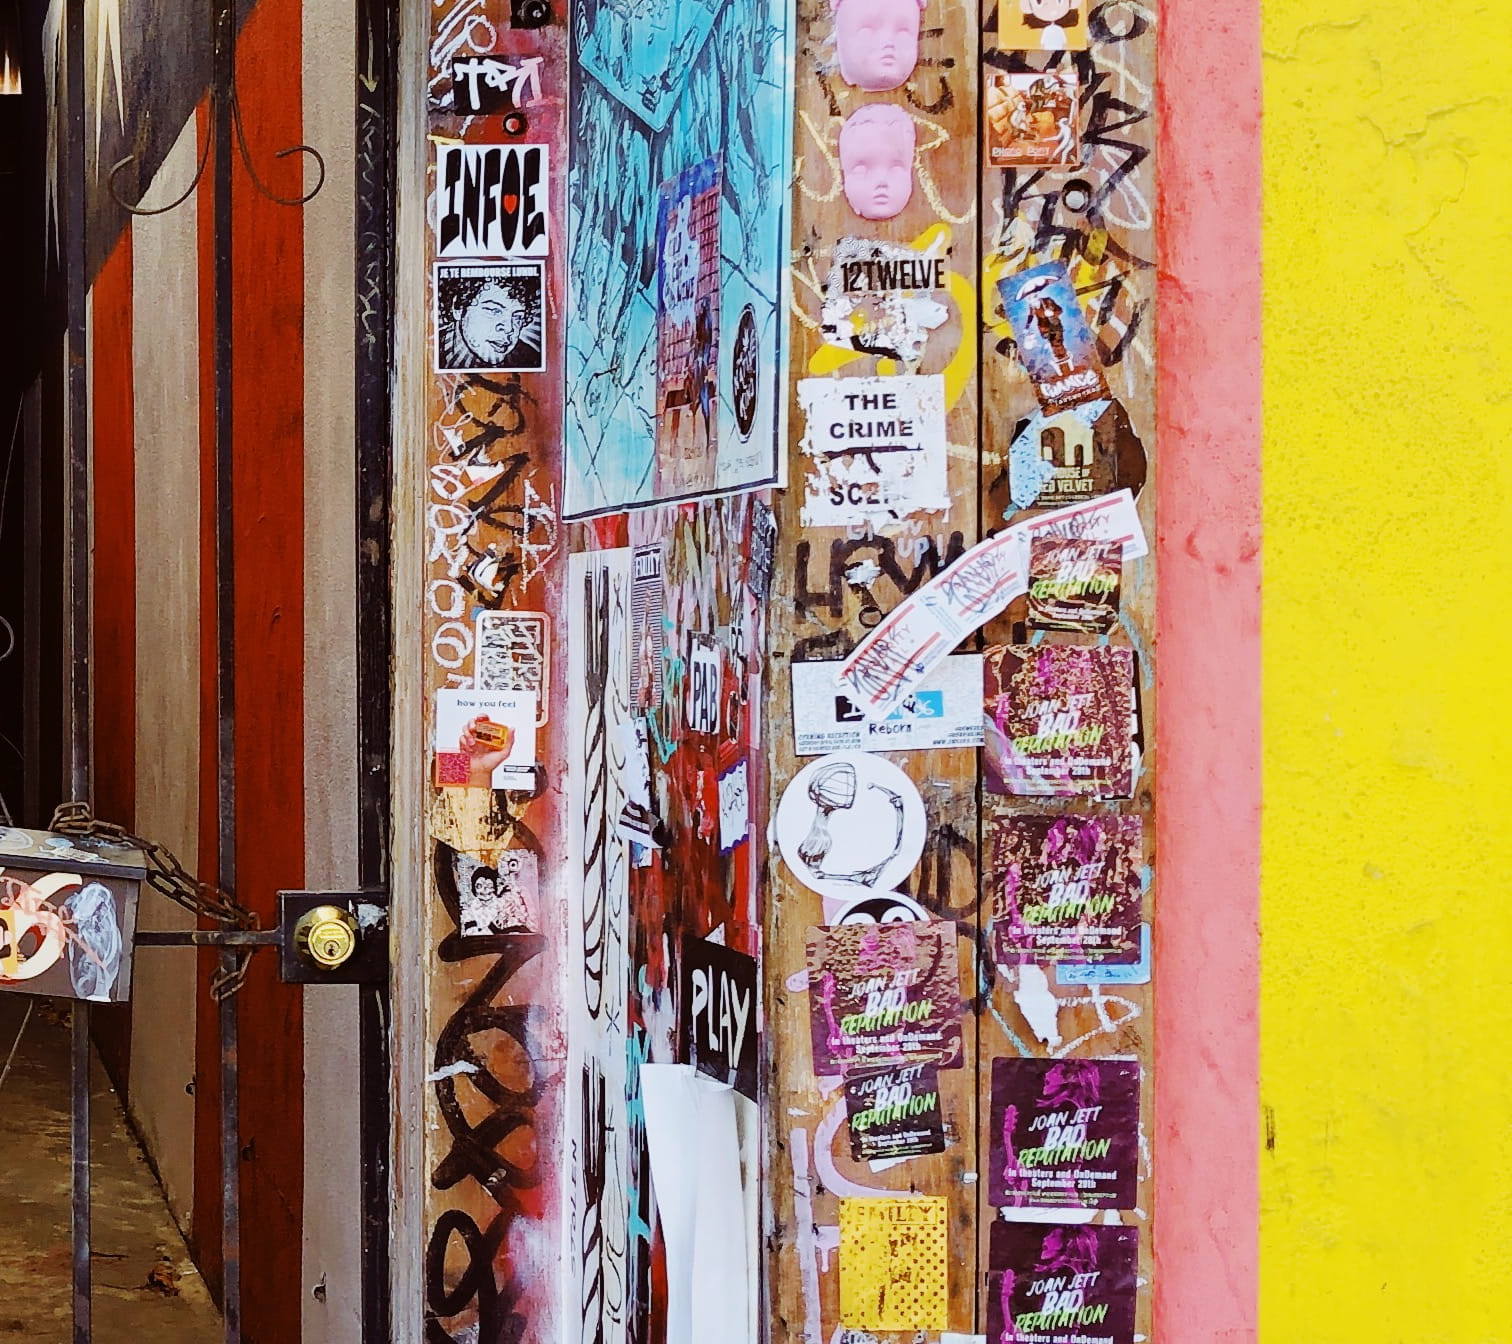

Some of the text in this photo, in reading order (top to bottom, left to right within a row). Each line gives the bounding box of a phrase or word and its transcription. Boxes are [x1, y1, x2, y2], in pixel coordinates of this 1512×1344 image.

[841, 258, 946, 292] 12TWELVE
[845, 393, 896, 412] THE
[829, 420, 914, 439] CRIME
[1058, 479, 1094, 492] VELVET
[869, 716, 912, 735] Reborn
[691, 968, 750, 1066] PLAY
[1028, 1107, 1102, 1132] JOAN JETT
[1044, 1124, 1086, 1150] BAD
[1018, 1139, 1110, 1168] REPUTATION
